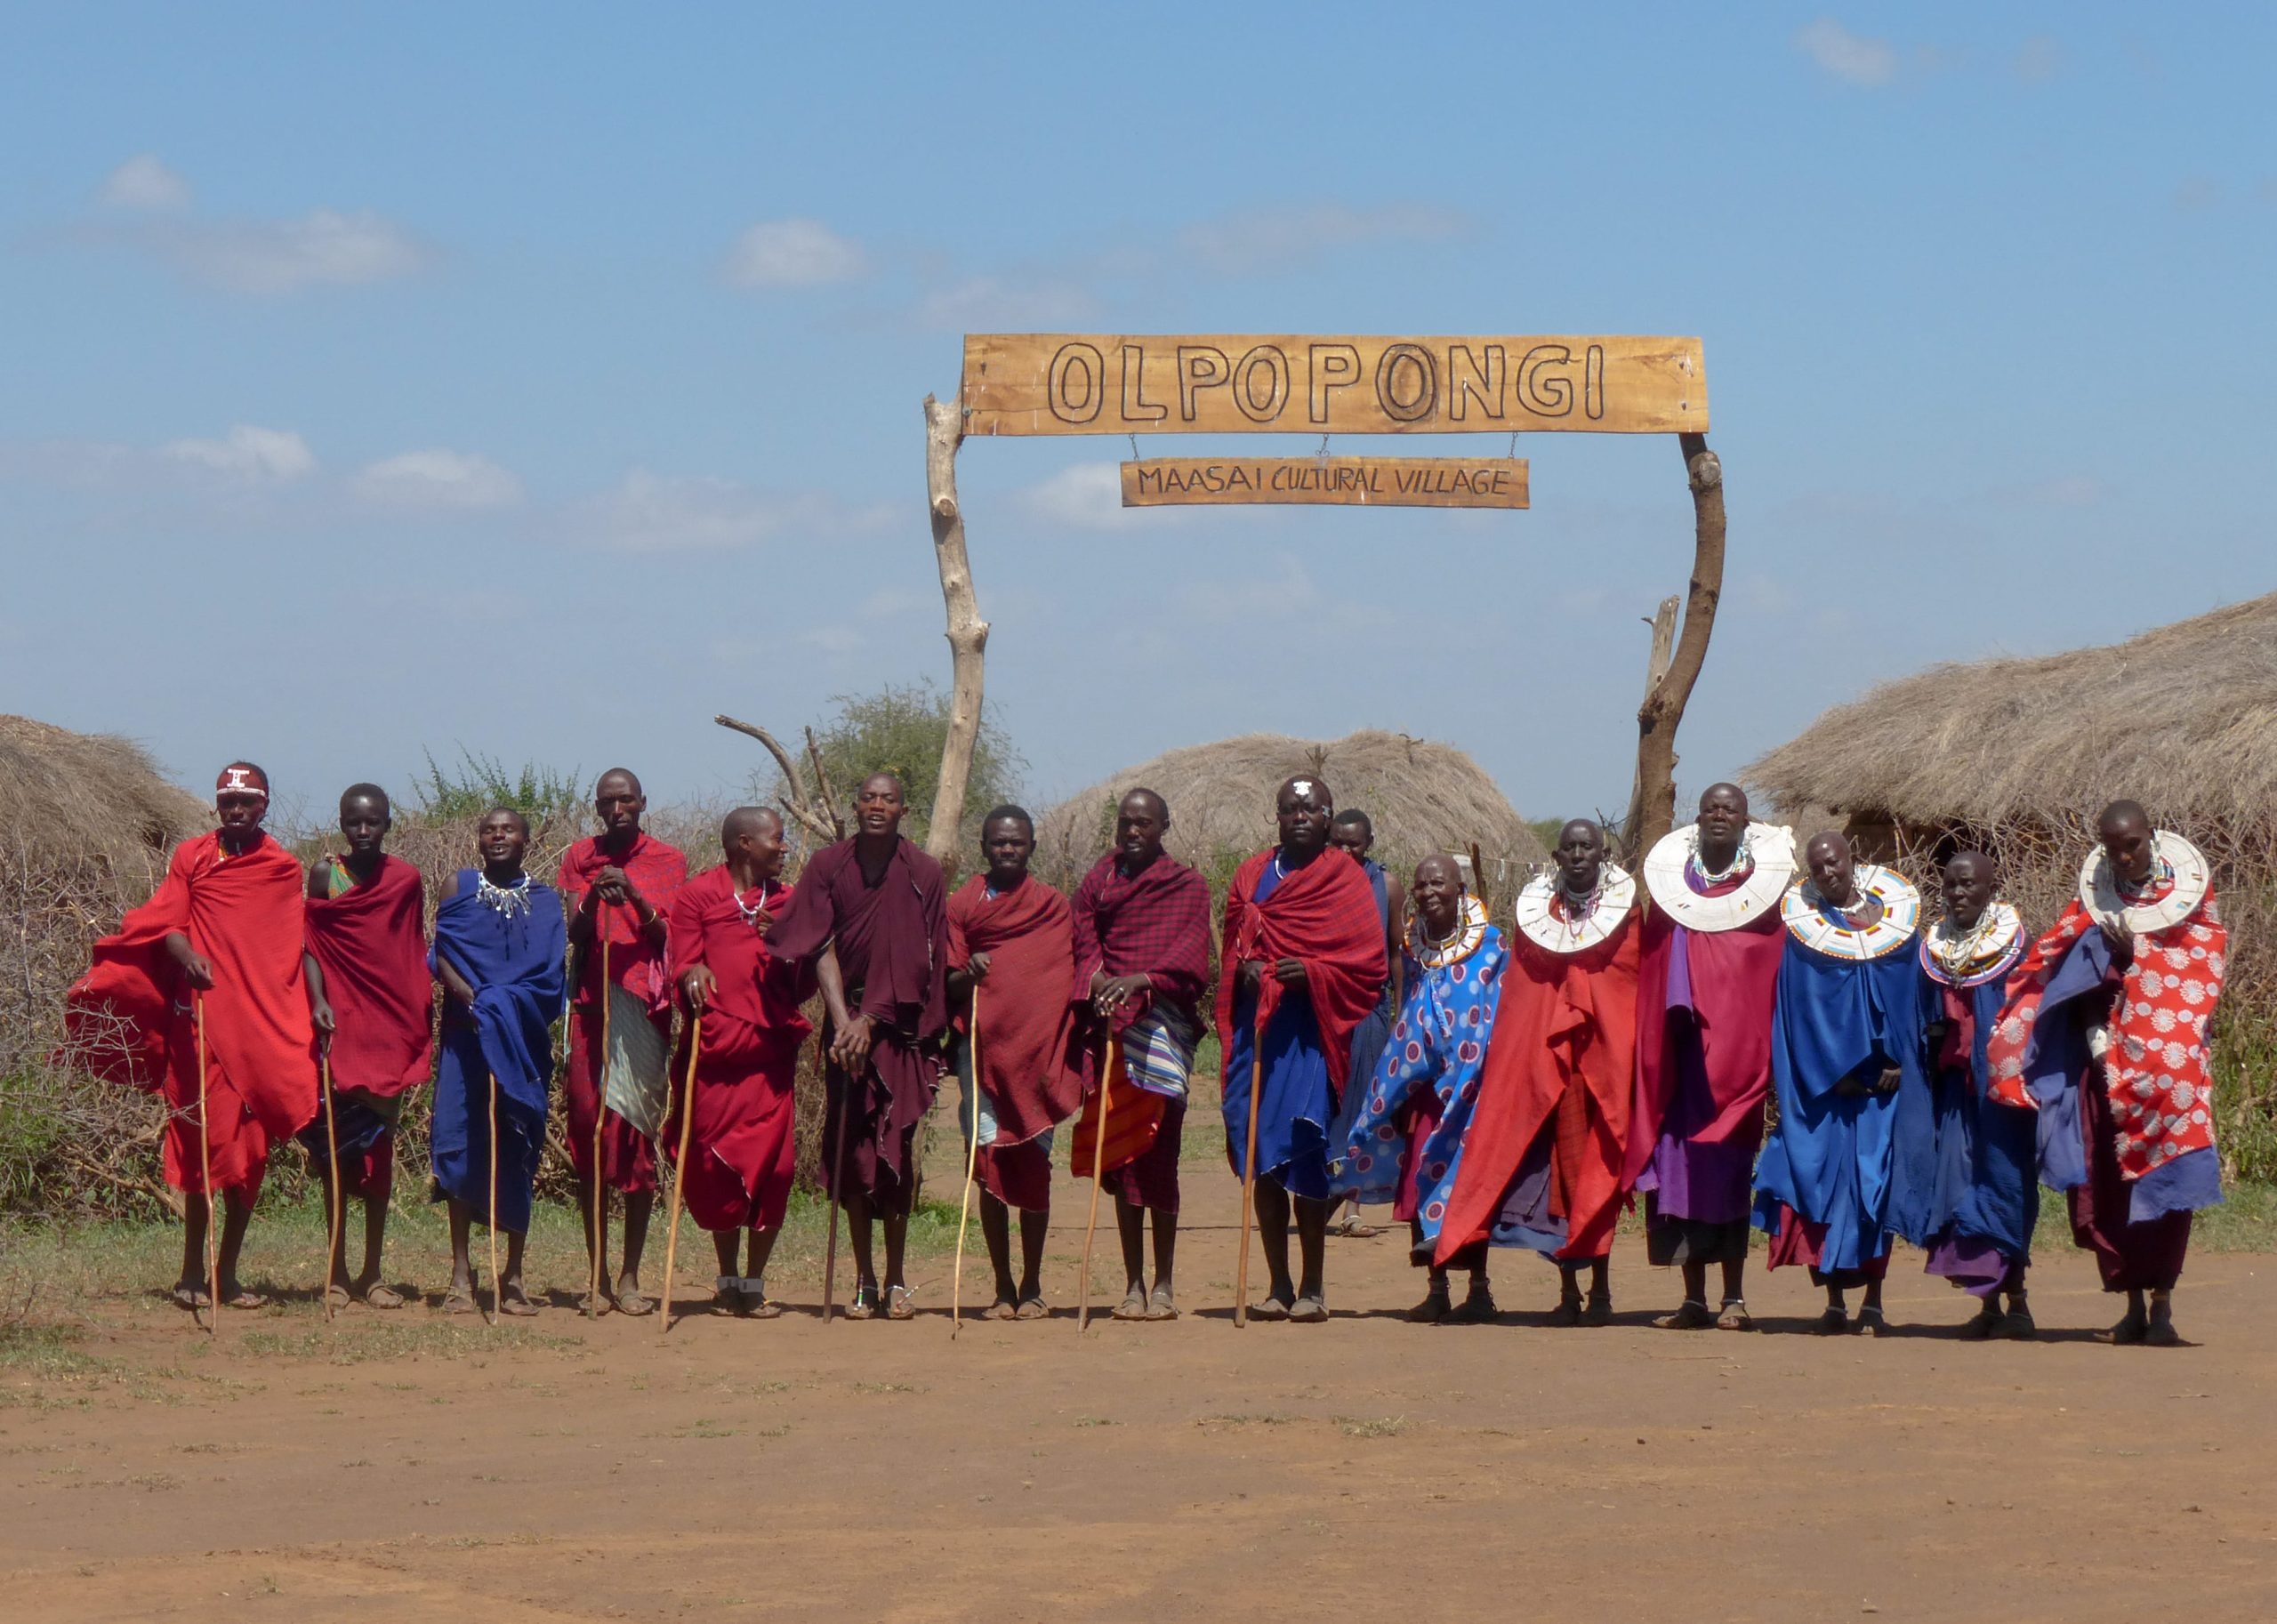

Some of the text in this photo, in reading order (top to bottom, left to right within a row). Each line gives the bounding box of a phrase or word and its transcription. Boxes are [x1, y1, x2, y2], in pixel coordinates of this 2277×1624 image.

[1048, 342, 1604, 423] OLPOPONGI
[1138, 466, 1509, 495] MAASAI CULTURAL VILLAGE
